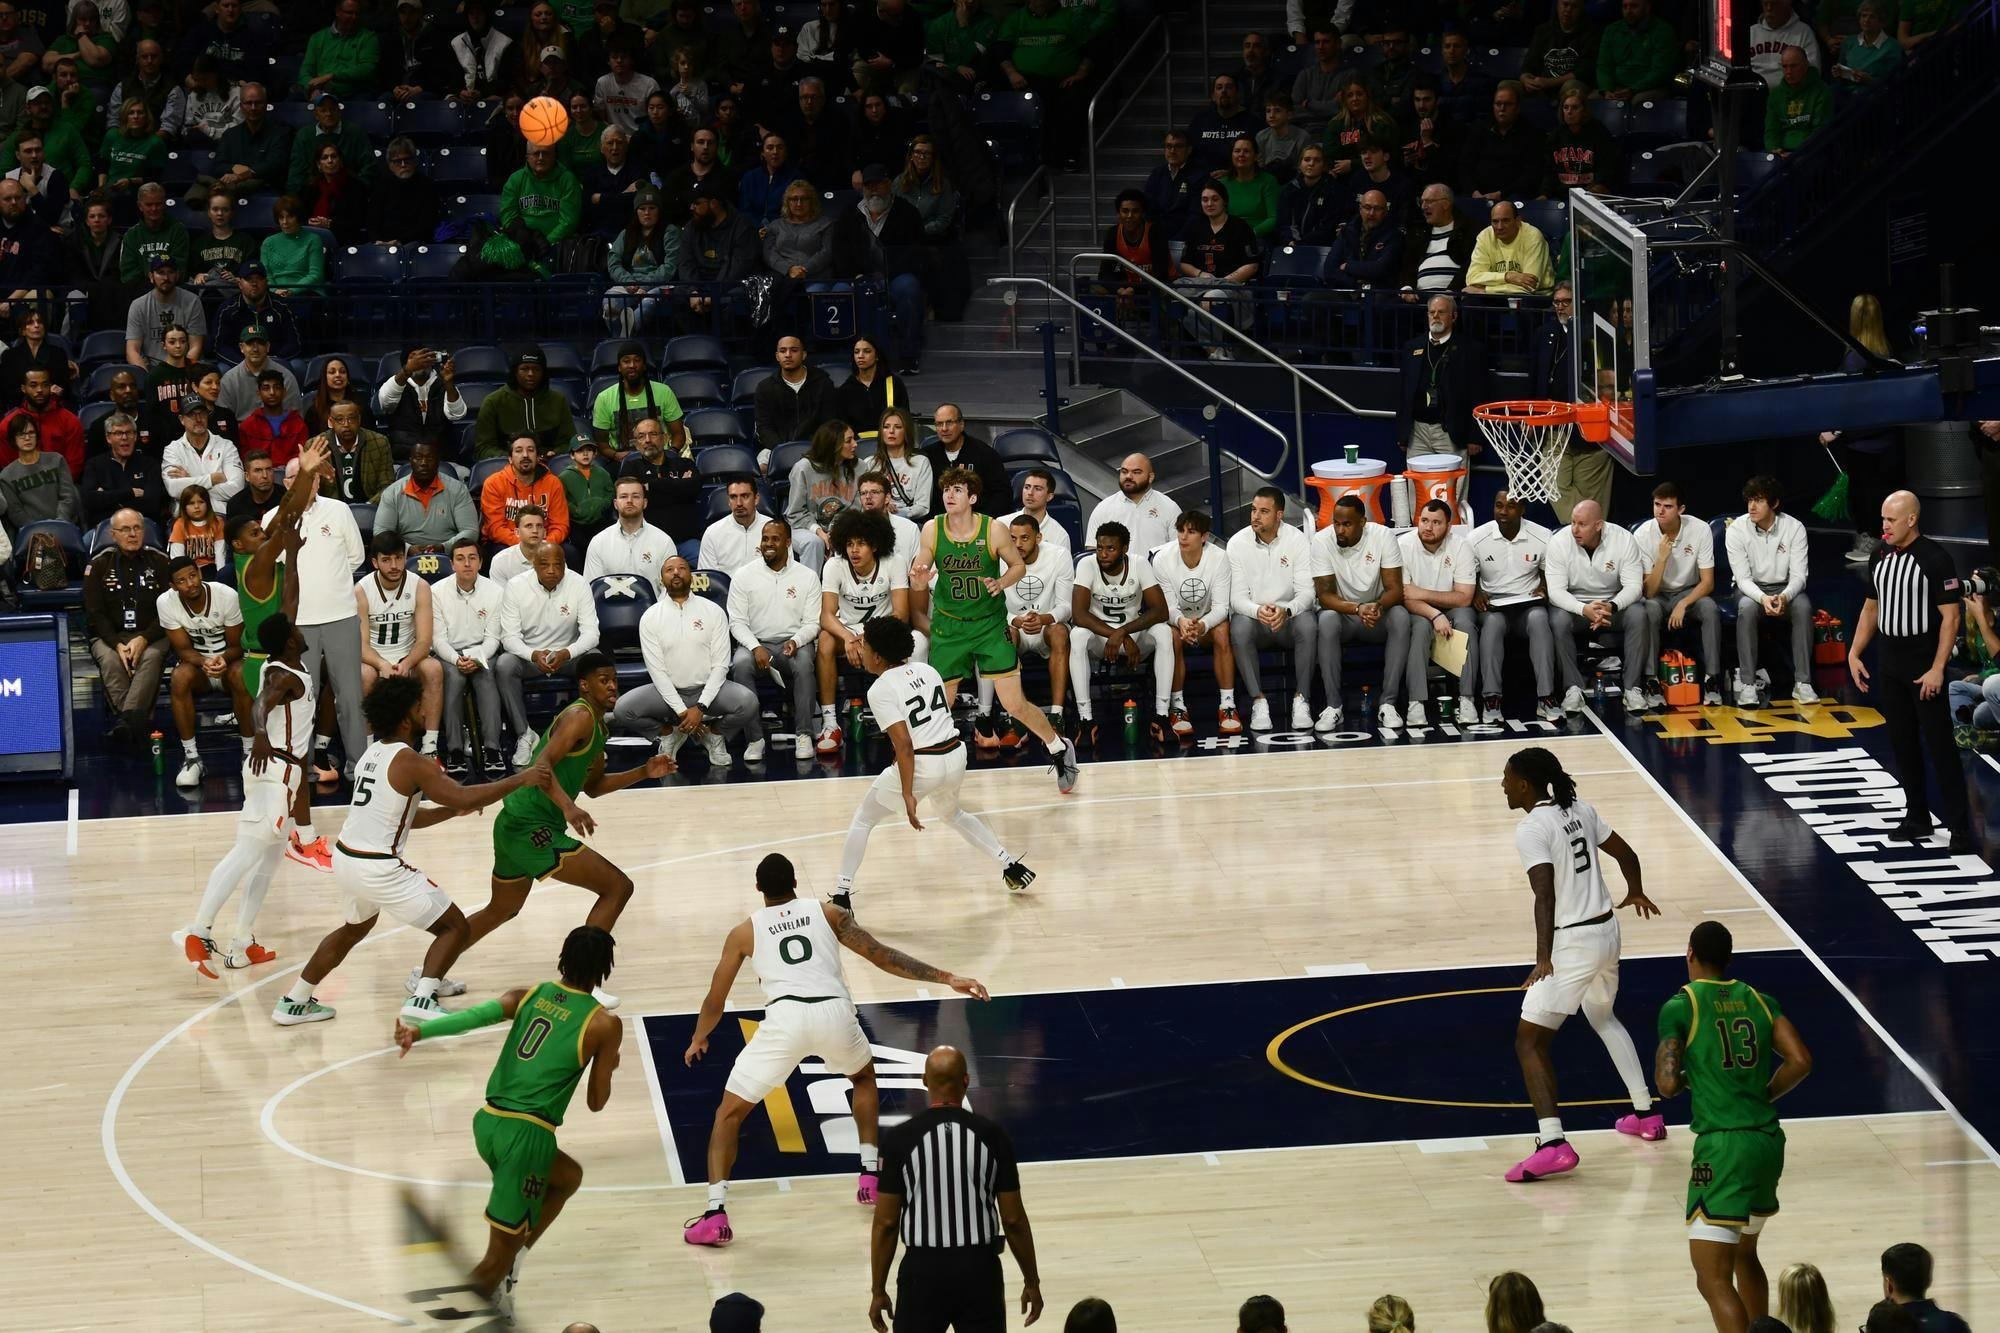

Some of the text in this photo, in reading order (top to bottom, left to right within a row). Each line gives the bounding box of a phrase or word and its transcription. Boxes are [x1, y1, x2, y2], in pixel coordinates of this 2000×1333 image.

[827, 306, 840, 324] 2
[12, 468, 60, 492] MIAMI
[417, 556, 441, 574] ND
[942, 554, 984, 574] Irish
[950, 576, 981, 601] 20
[854, 605, 877, 624] 7
[1103, 606, 1127, 624] 5
[377, 622, 400, 645] 11
[0, 677, 22, 697] M
[1671, 673, 1680, 684] G
[1685, 672, 1694, 683] G
[905, 685, 950, 729] 24
[1124, 713, 1133, 724] G
[152, 743, 160, 755] G
[1739, 747, 1953, 854] NOTRE
[1570, 837, 1591, 874] 3
[1846, 854, 2000, 963] DAME
[768, 915, 811, 936] CLEVELAND
[779, 934, 813, 965] 0
[533, 997, 573, 1023] BOOTH
[1713, 1000, 1747, 1014] DAVIS
[516, 1015, 553, 1062] 0
[1715, 1016, 1759, 1070] 13
[1691, 1163, 1713, 1188] ND
